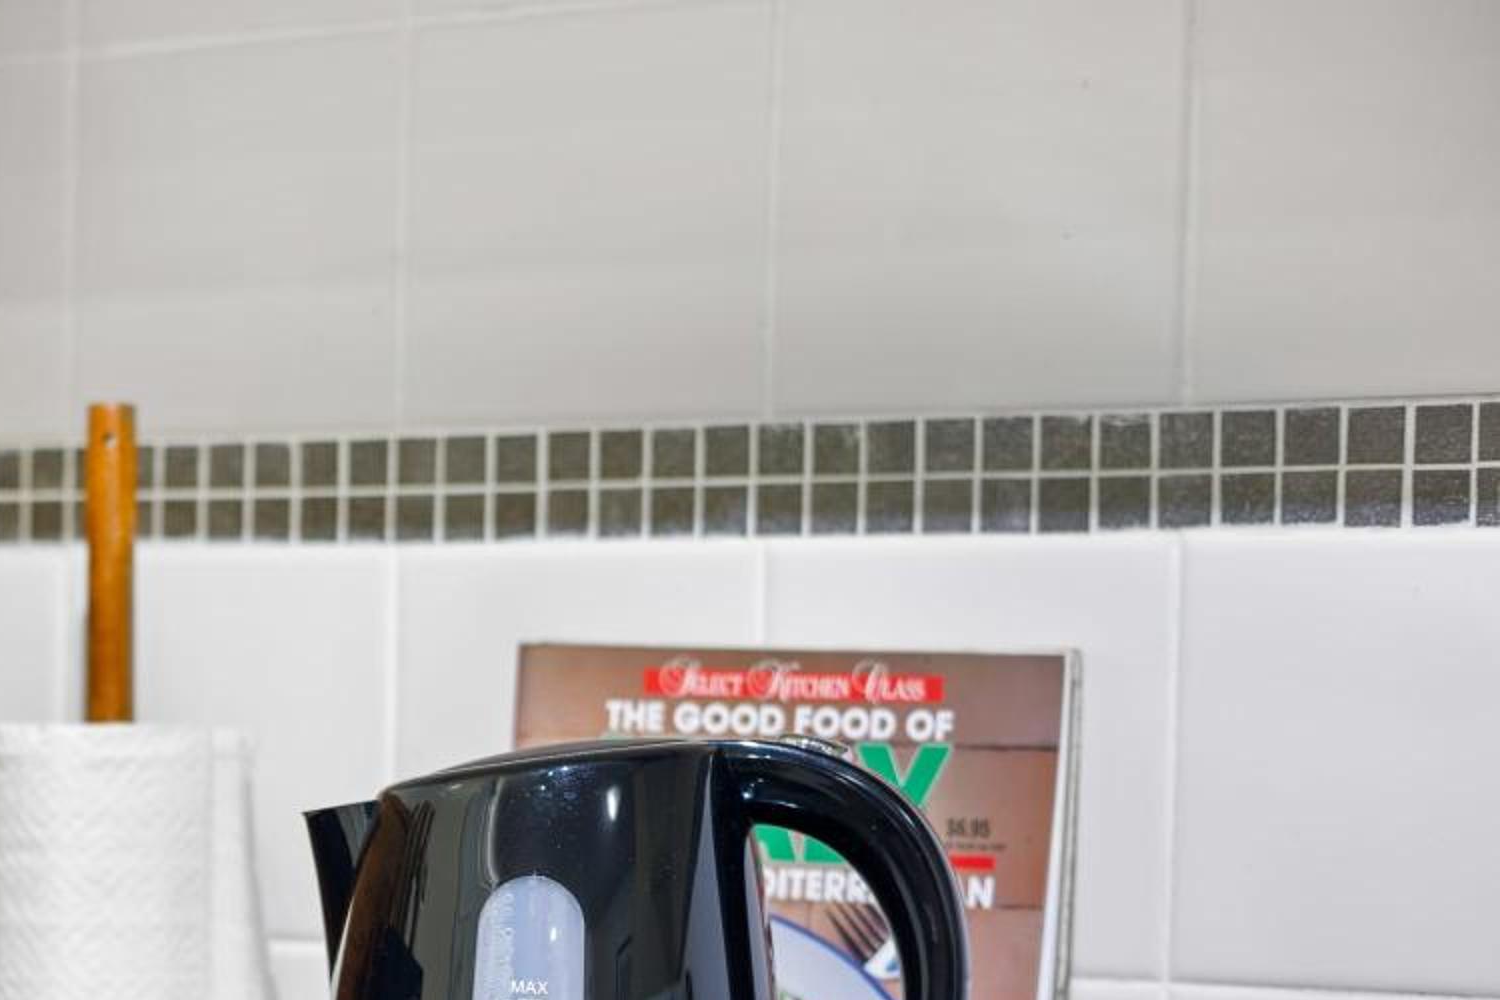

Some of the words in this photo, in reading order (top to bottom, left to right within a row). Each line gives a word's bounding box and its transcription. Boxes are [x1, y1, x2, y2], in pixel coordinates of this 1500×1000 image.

[606, 700, 666, 733] THE
[673, 705, 785, 735] GOOD
[794, 707, 896, 738] FOOD
[905, 709, 955, 741] OF
[511, 979, 549, 995] MAX
